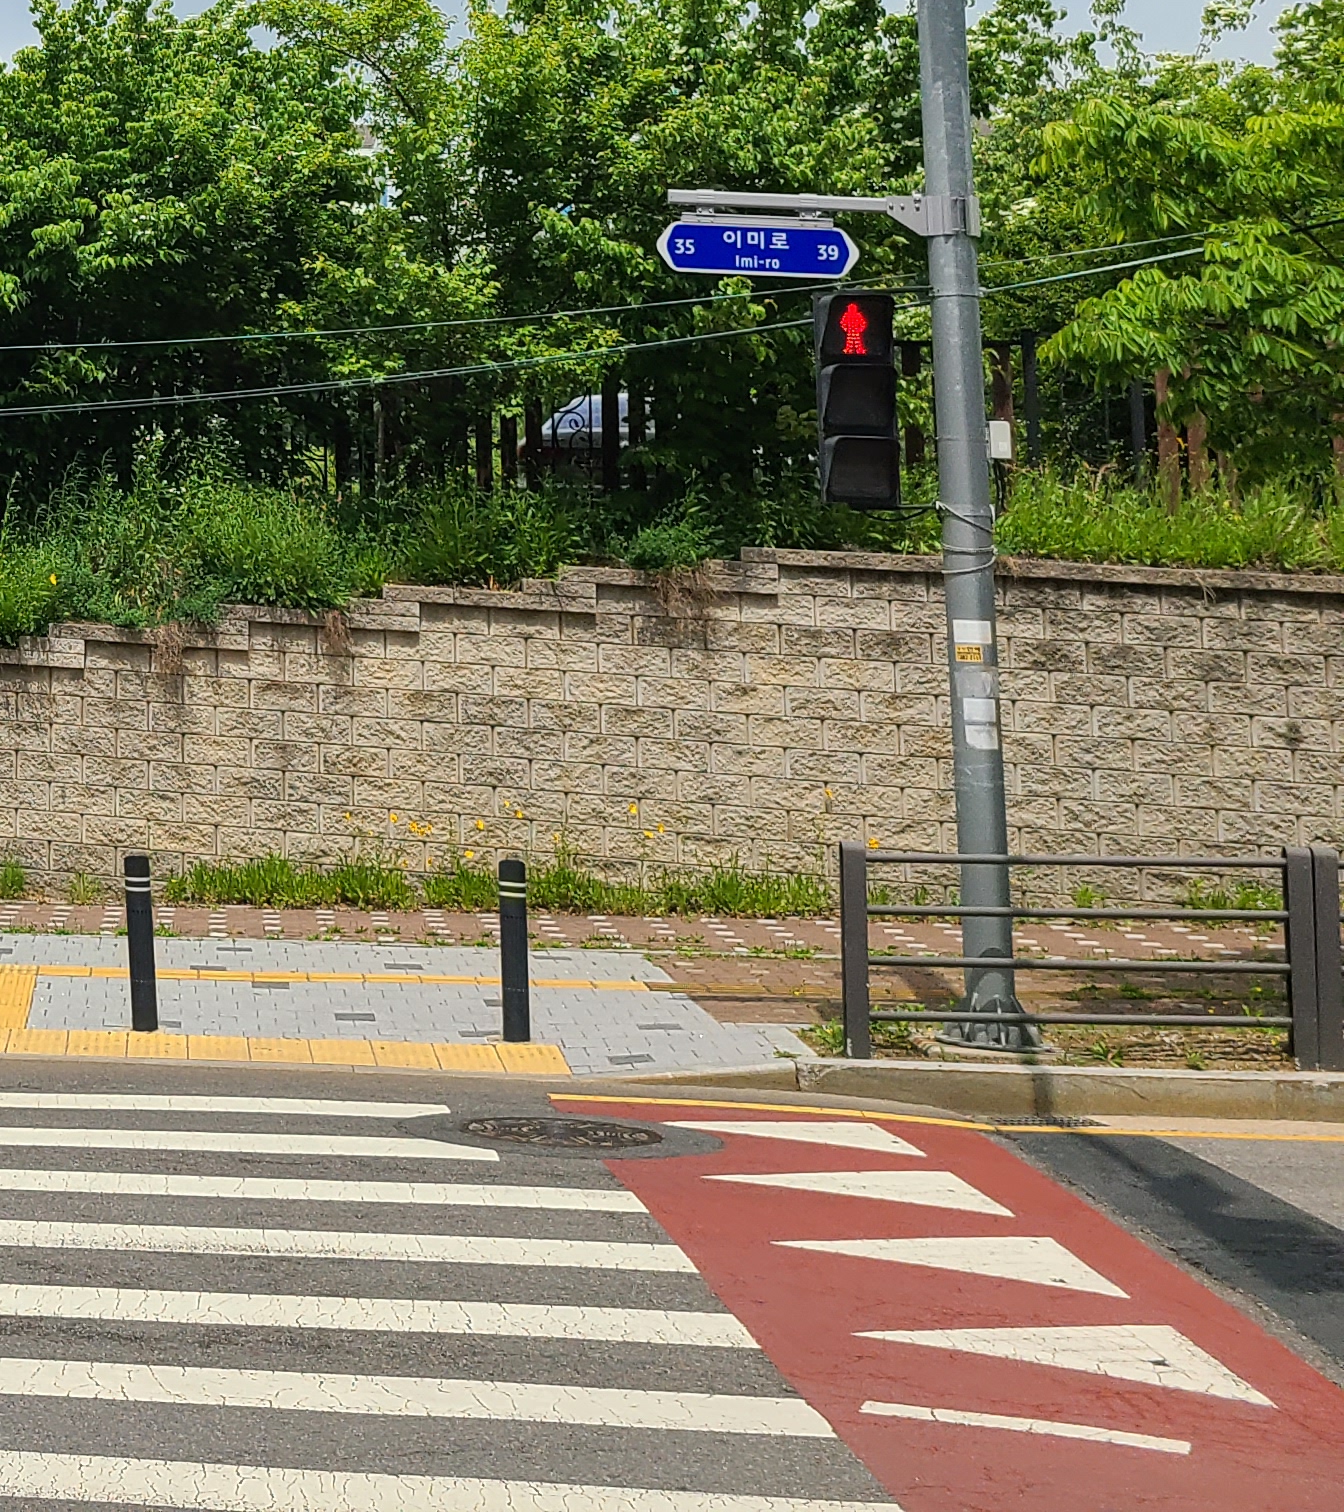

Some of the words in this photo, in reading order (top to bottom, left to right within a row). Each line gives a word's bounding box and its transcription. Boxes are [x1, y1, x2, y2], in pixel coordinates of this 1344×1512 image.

[674, 238, 695, 255] 35
[722, 230, 790, 250] 이미로
[816, 244, 839, 261] 39
[735, 254, 780, 269] Imi-ro
